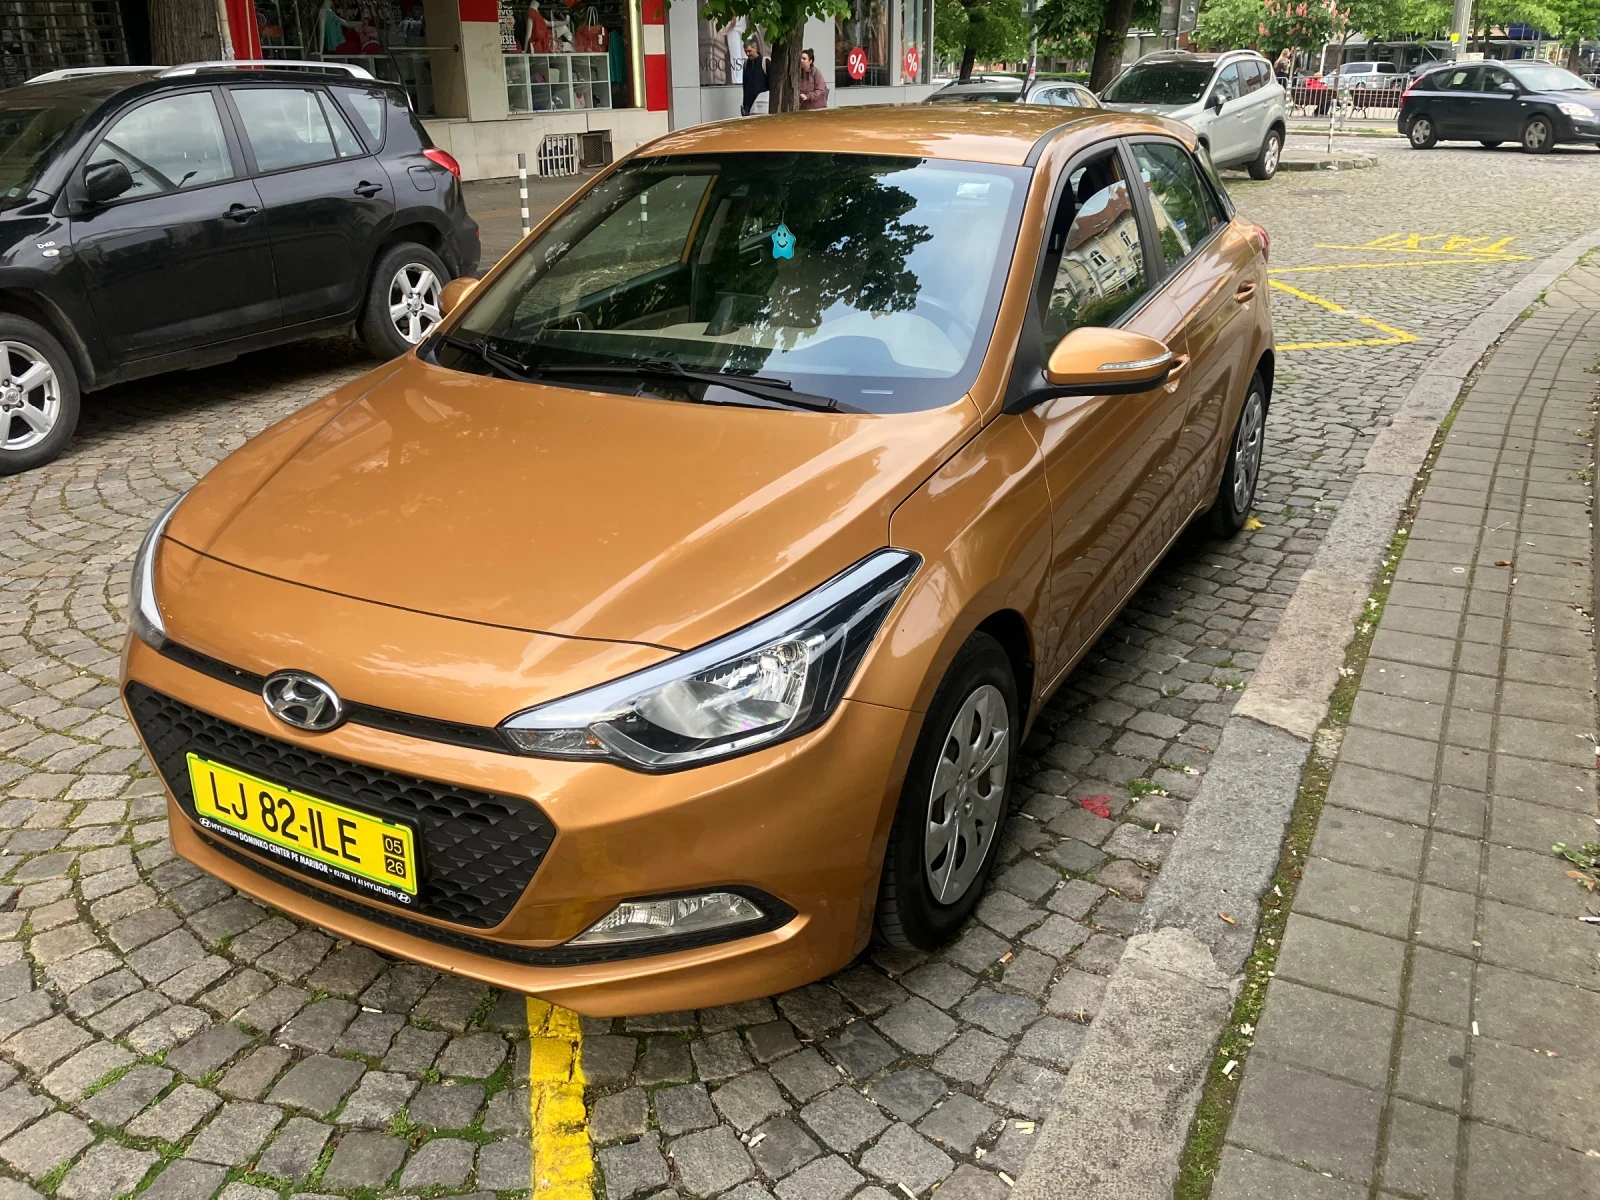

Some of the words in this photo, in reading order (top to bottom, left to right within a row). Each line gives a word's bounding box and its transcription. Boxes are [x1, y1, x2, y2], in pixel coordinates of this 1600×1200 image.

[209, 771, 249, 820] LJ
[258, 791, 361, 864] 82-ILE
[239, 832, 269, 850] DOMINKO
[268, 843, 291, 859] CENTER
[291, 852, 300, 862] PE
[299, 855, 329, 874] MARIBOR
[363, 881, 397, 898] HYUNDAI
[384, 838, 403, 855] 05
[386, 858, 405, 876] 26
